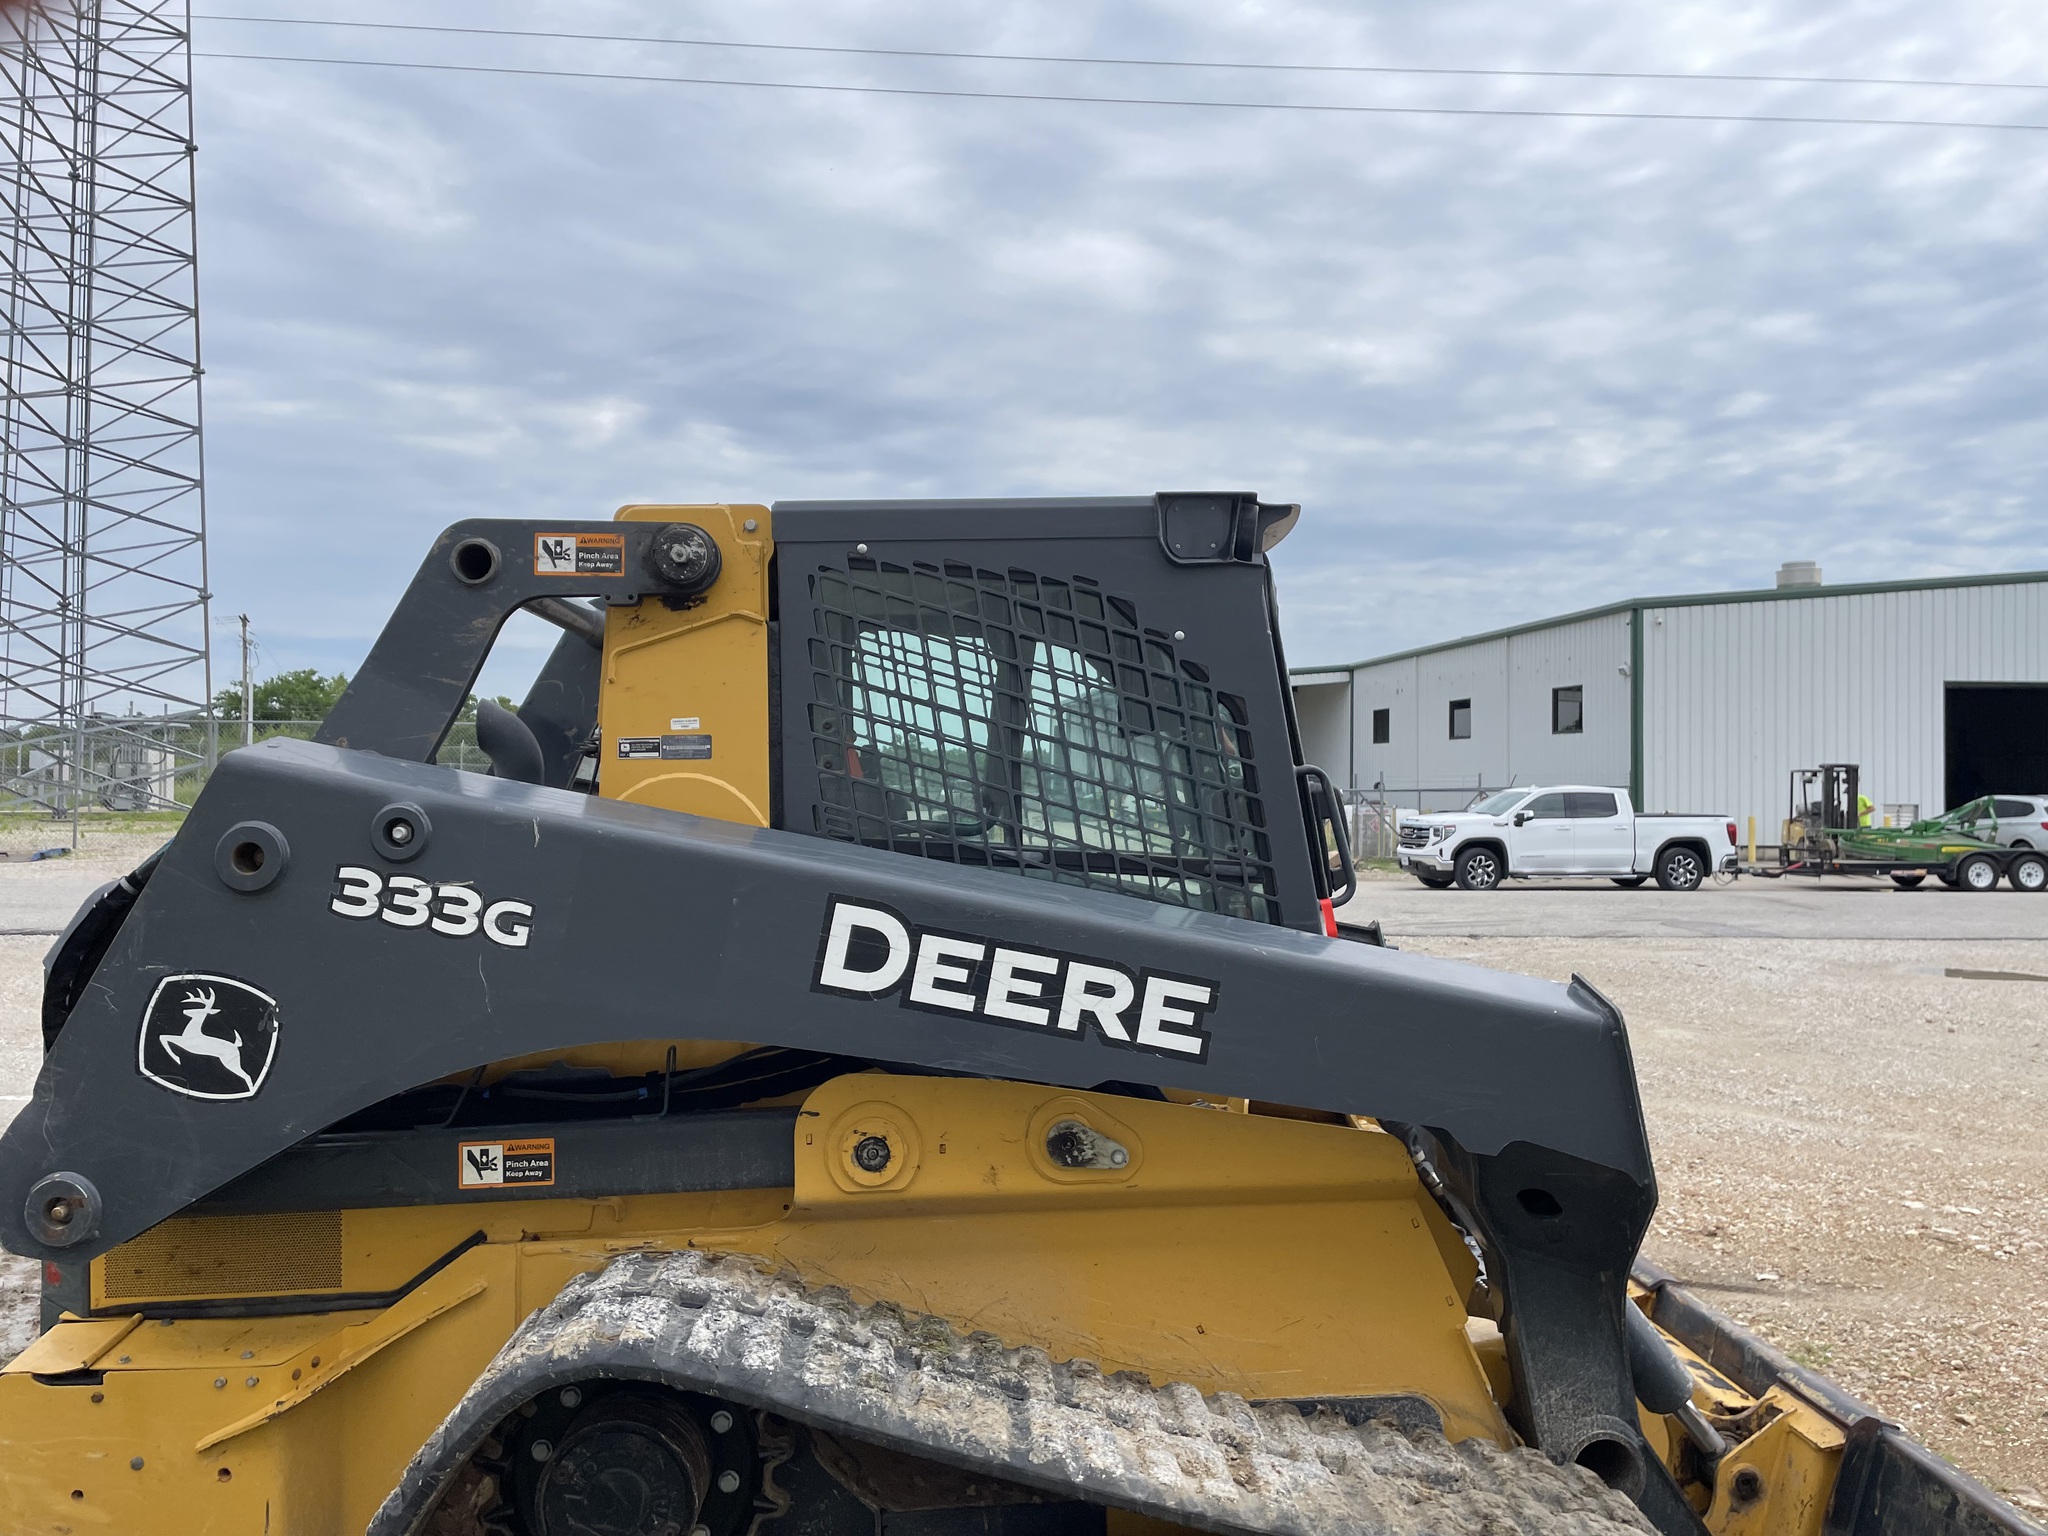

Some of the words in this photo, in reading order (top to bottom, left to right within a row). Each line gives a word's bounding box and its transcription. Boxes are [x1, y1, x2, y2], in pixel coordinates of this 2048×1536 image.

[578, 552, 600, 560] Pinch
[331, 866, 533, 947] 333G
[819, 902, 1211, 1055] DEERE
[514, 1143, 550, 1151] WARNING
[506, 1160, 529, 1168] Pinch
